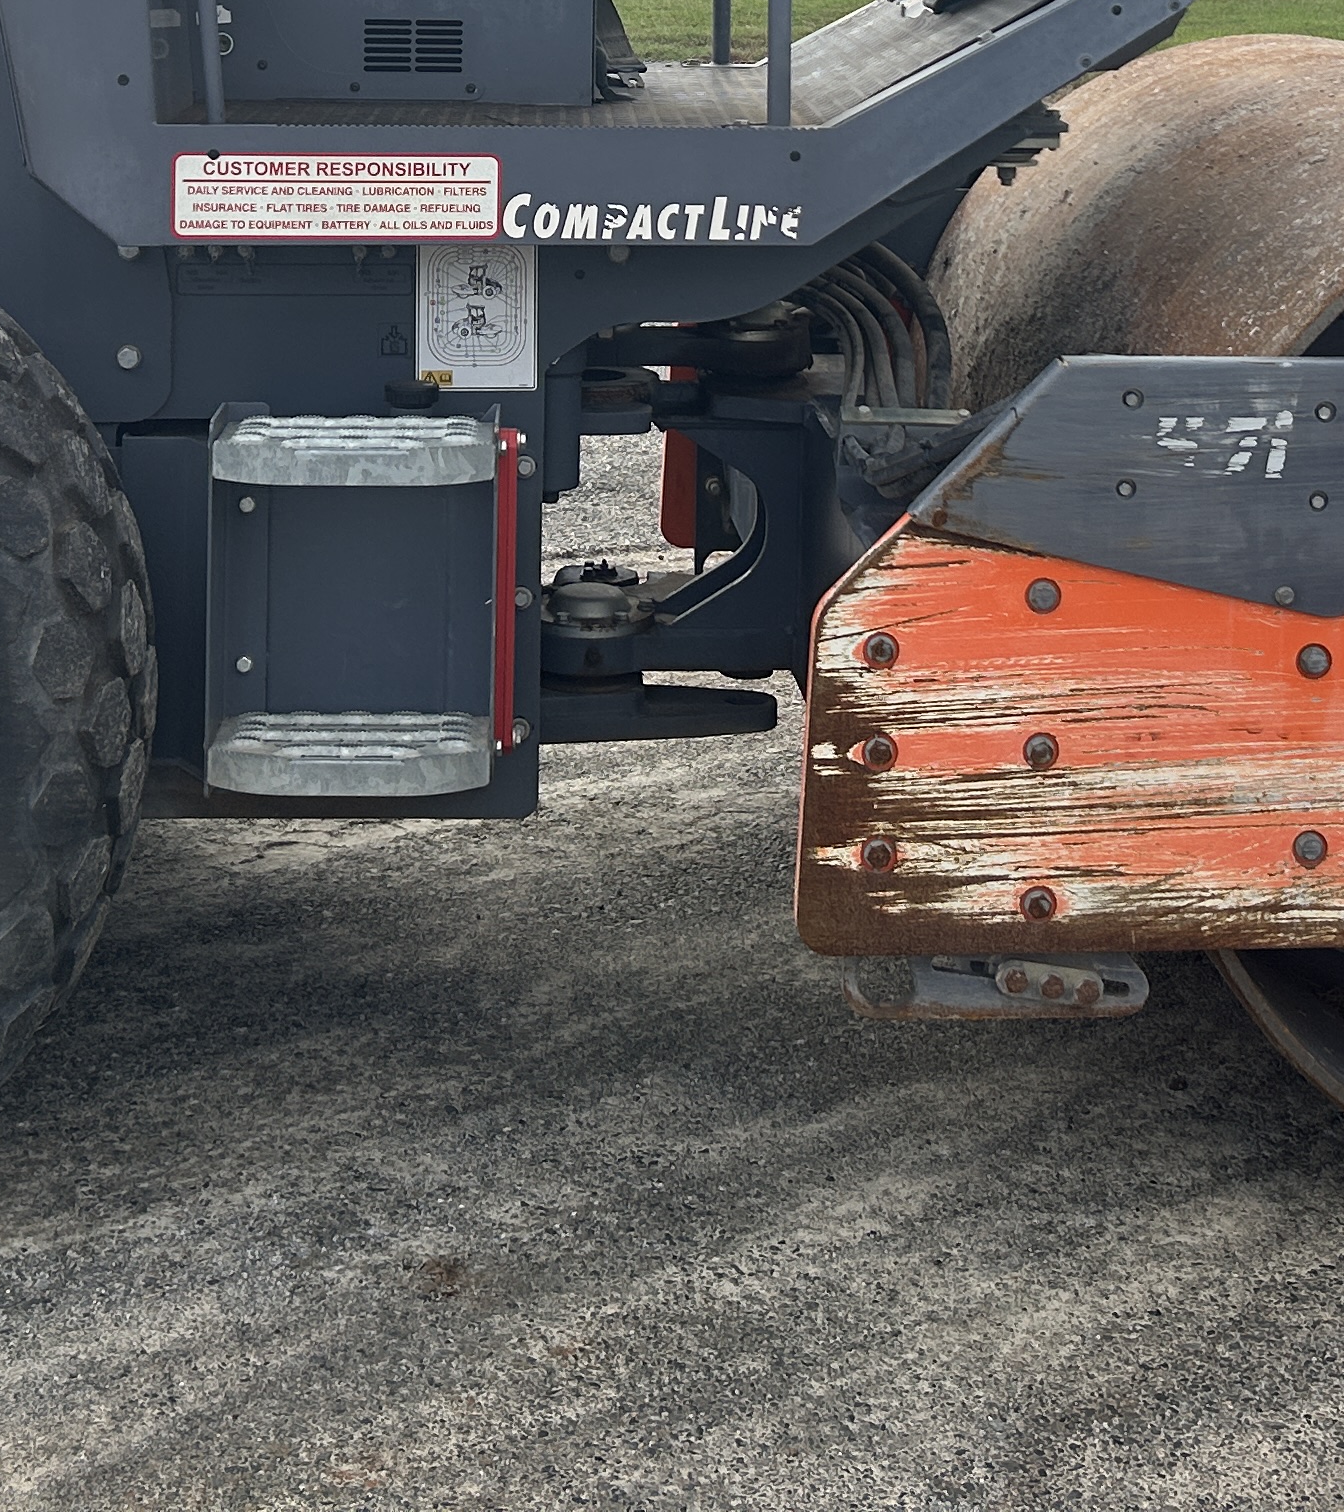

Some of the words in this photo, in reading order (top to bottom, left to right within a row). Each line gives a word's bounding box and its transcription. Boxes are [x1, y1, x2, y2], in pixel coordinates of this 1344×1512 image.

[203, 161, 310, 176] CUSTOMER
[316, 162, 472, 177] RESPONSIBILITY
[187, 185, 219, 196] DAILY
[221, 185, 268, 196] SERVICE
[271, 186, 294, 196] AND
[297, 186, 353, 196] CLEANING
[362, 187, 434, 196] LUBRICATION
[443, 187, 487, 196] FILTERS
[192, 202, 257, 213] INSURANCE
[266, 203, 293, 213] FLAT
[295, 203, 328, 213] TIRES
[336, 203, 361, 213] TIRE
[363, 203, 411, 213] DAMAGE
[419, 203, 481, 213] REFUELING
[179, 219, 228, 230] DAMAGE
[230, 219, 246, 230] TO
[248, 220, 313, 230] EQUIPMENT
[321, 220, 371, 230] BATTERY
[379, 220, 400, 230] ALL
[402, 220, 427, 230] OILS
[429, 220, 453, 230] AND
[455, 220, 494, 230] FLUIDS
